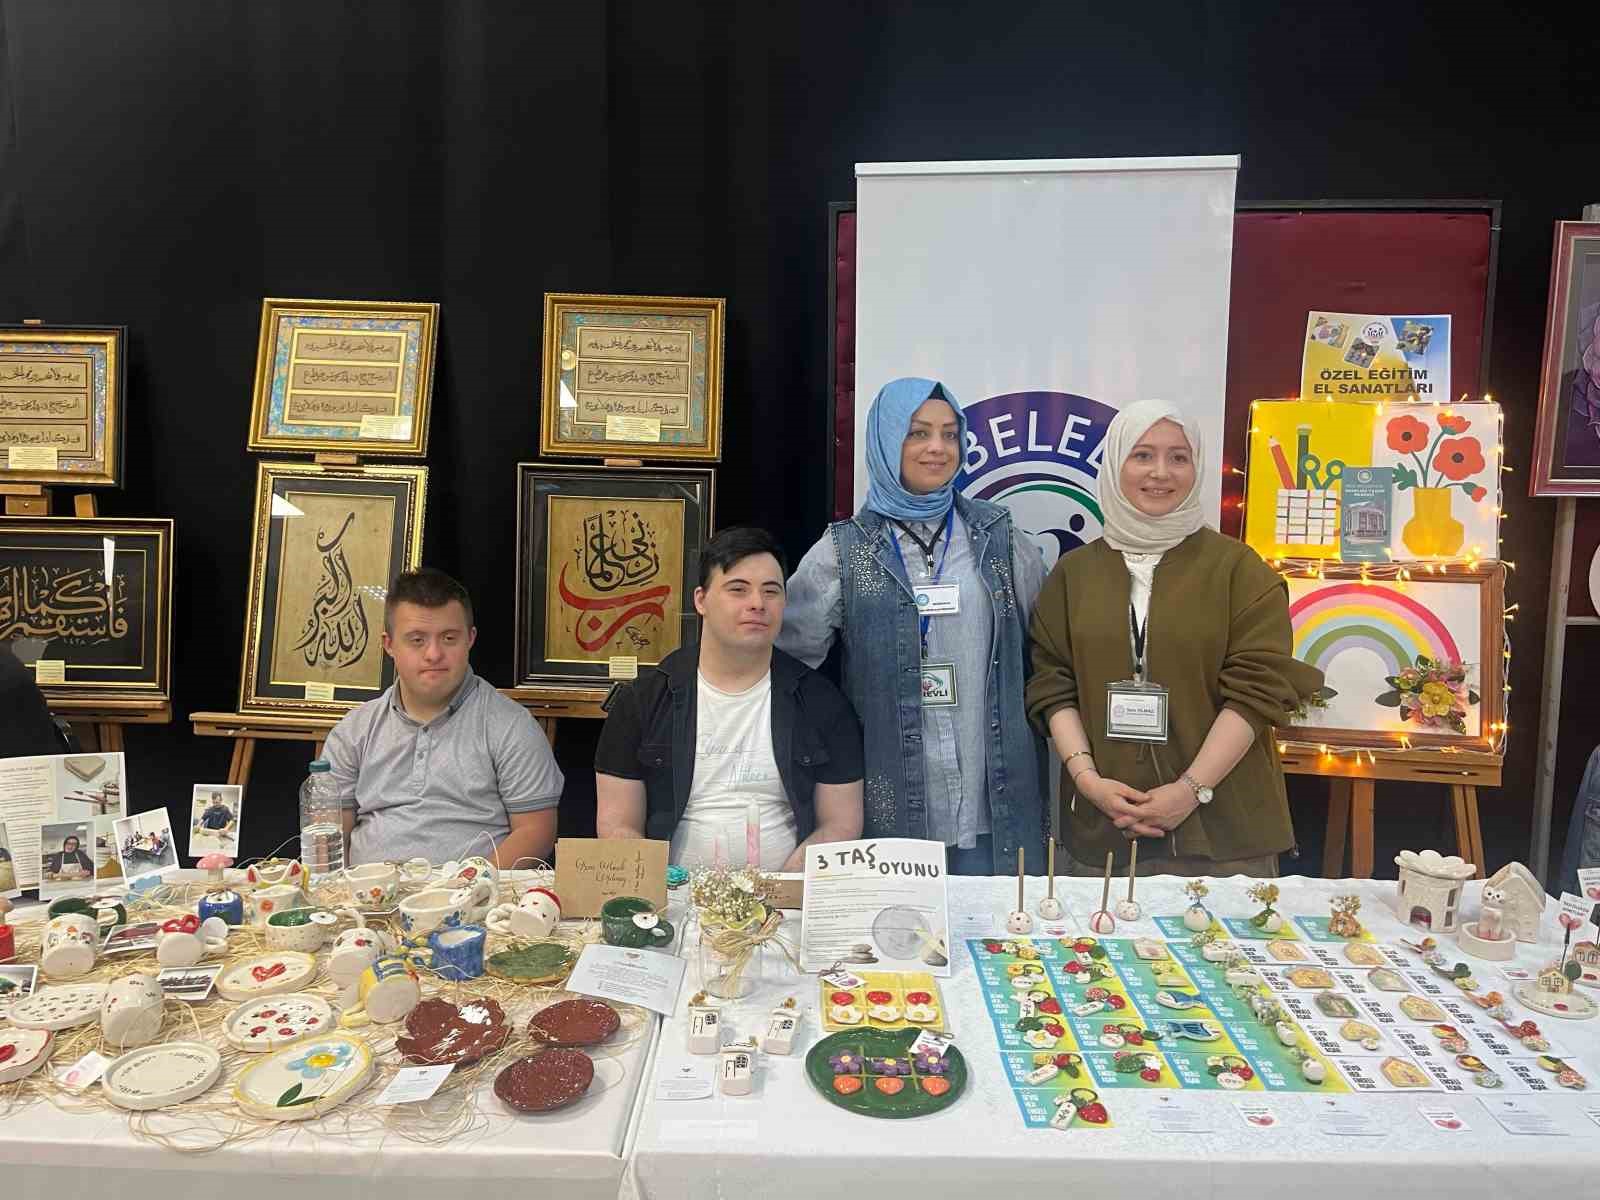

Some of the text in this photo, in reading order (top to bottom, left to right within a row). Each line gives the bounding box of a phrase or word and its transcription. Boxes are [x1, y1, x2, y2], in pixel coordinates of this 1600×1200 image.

[1320, 367, 1428, 380] ÖZEL EĞİTİM
[1313, 383, 1433, 394] EL SANATLARI
[817, 843, 940, 878] 3 TAŞ OYUNU
